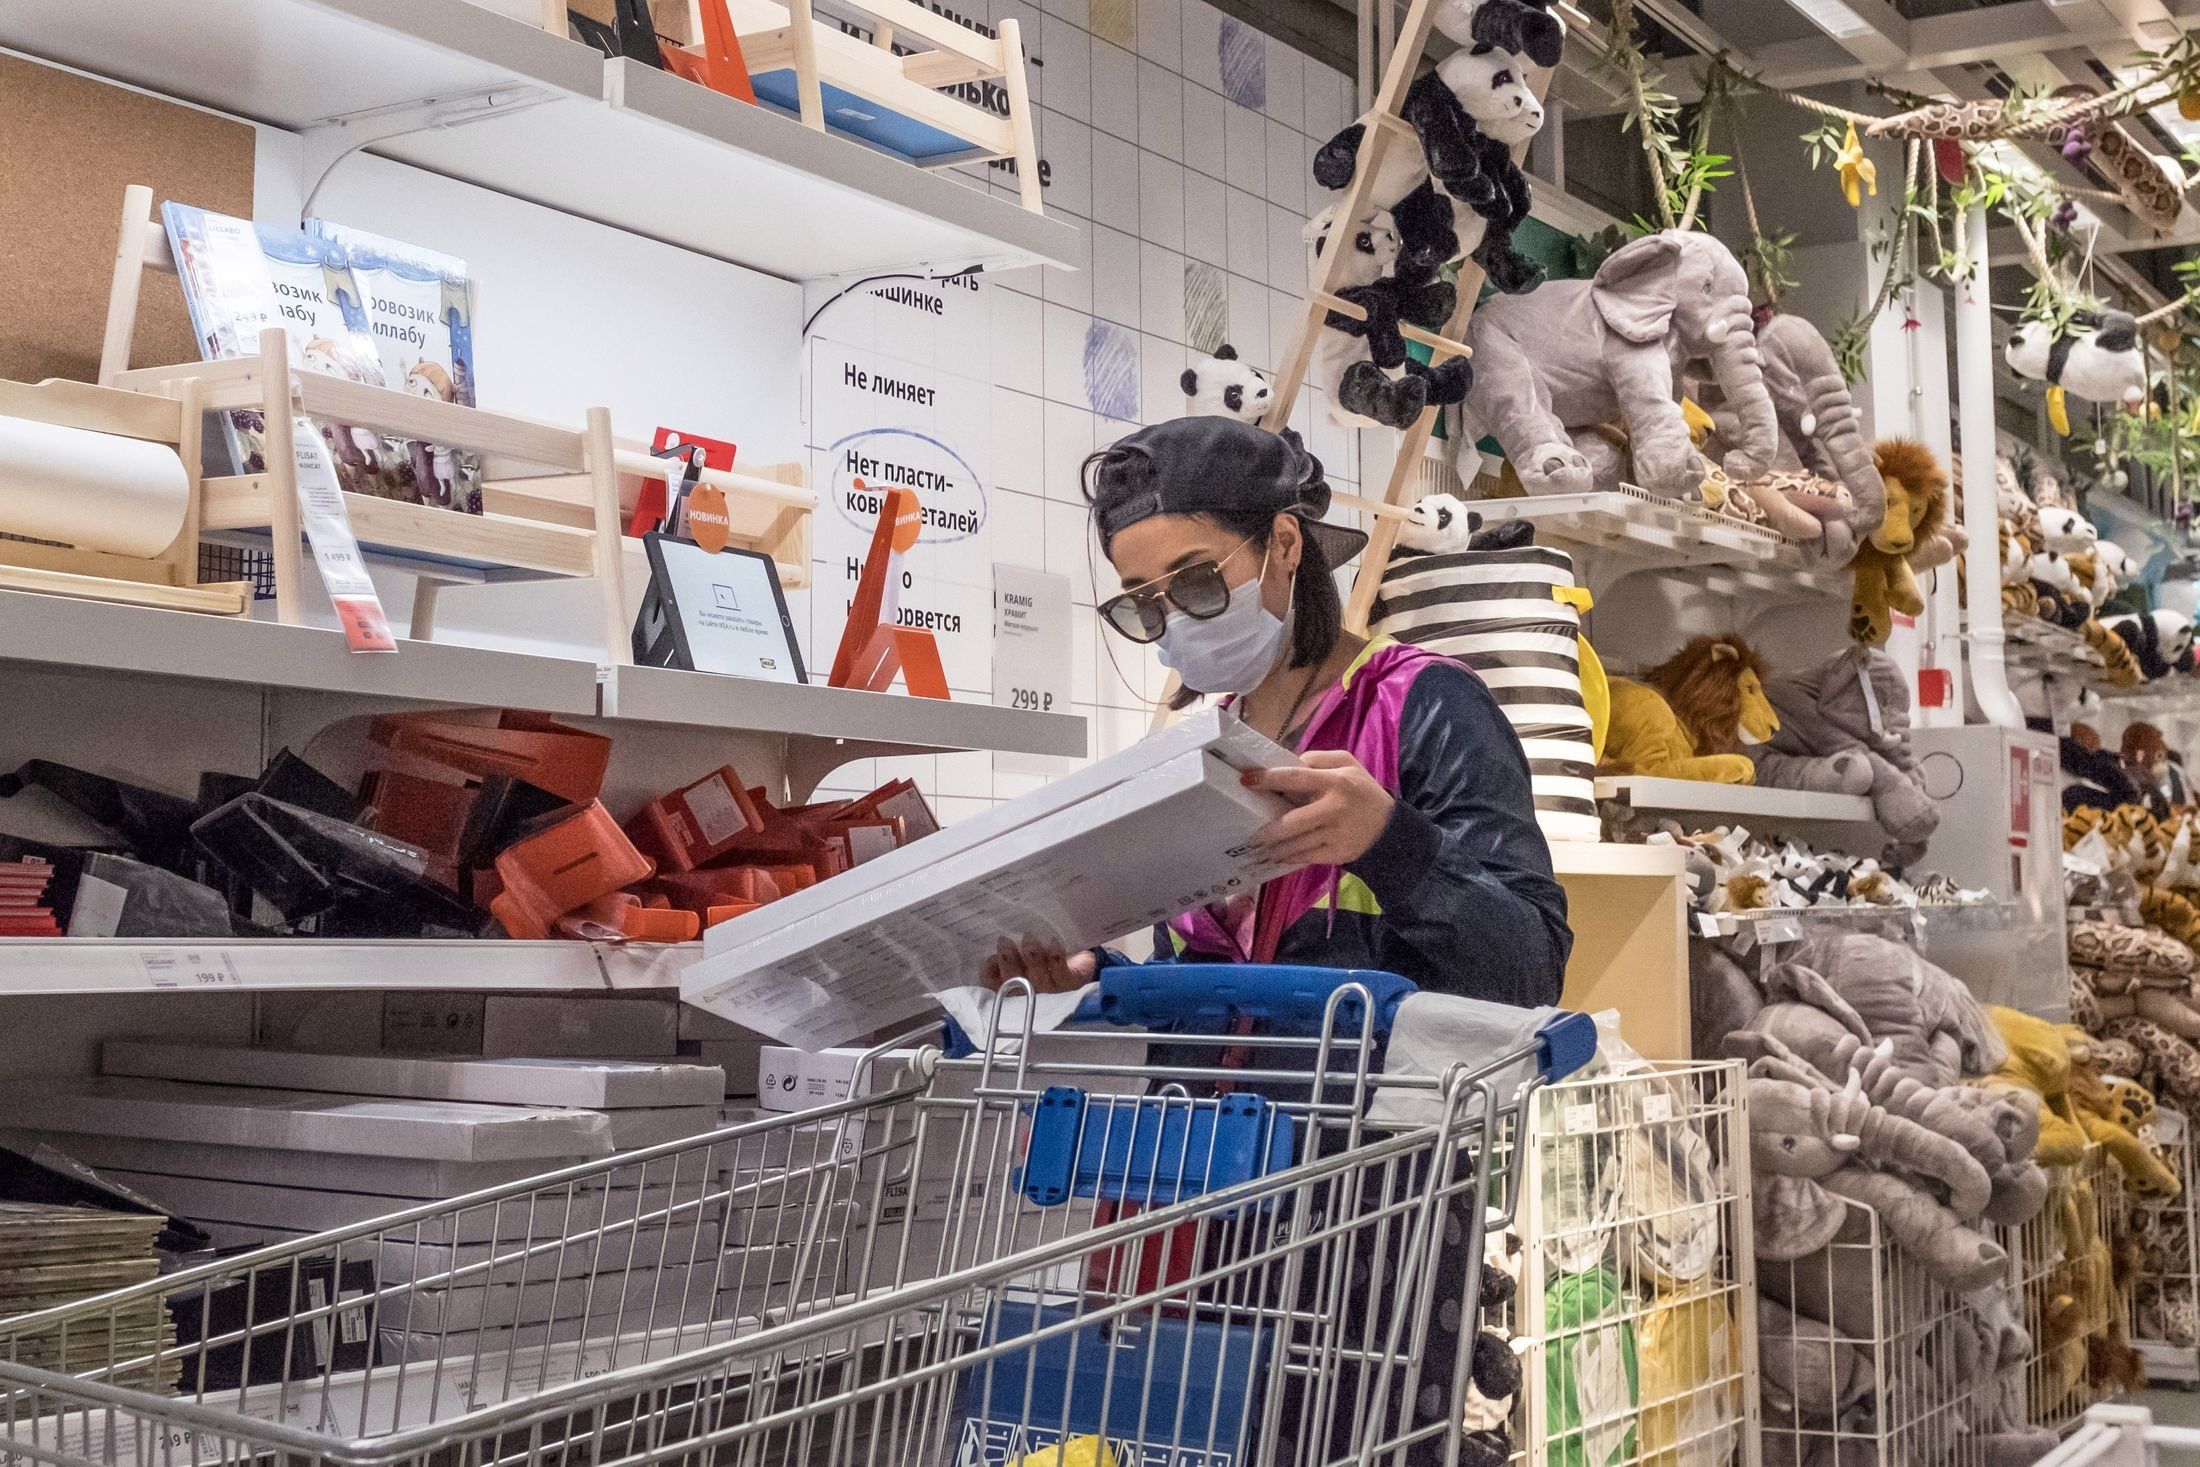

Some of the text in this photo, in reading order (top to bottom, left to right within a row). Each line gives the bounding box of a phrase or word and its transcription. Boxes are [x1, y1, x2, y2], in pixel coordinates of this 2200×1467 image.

[844, 362, 936, 406] Не линяет
[295, 451, 318, 460] FLISAT
[847, 449, 880, 478] Нет
[689, 510, 729, 526] НОВИНКА
[895, 511, 921, 527] ВИНКА
[920, 506, 978, 535] еталей
[1004, 593, 1033, 608] KRAMIG
[1011, 688, 1039, 710] 299
[195, 973, 216, 983] 199
[885, 1187, 908, 1198] FLISA
